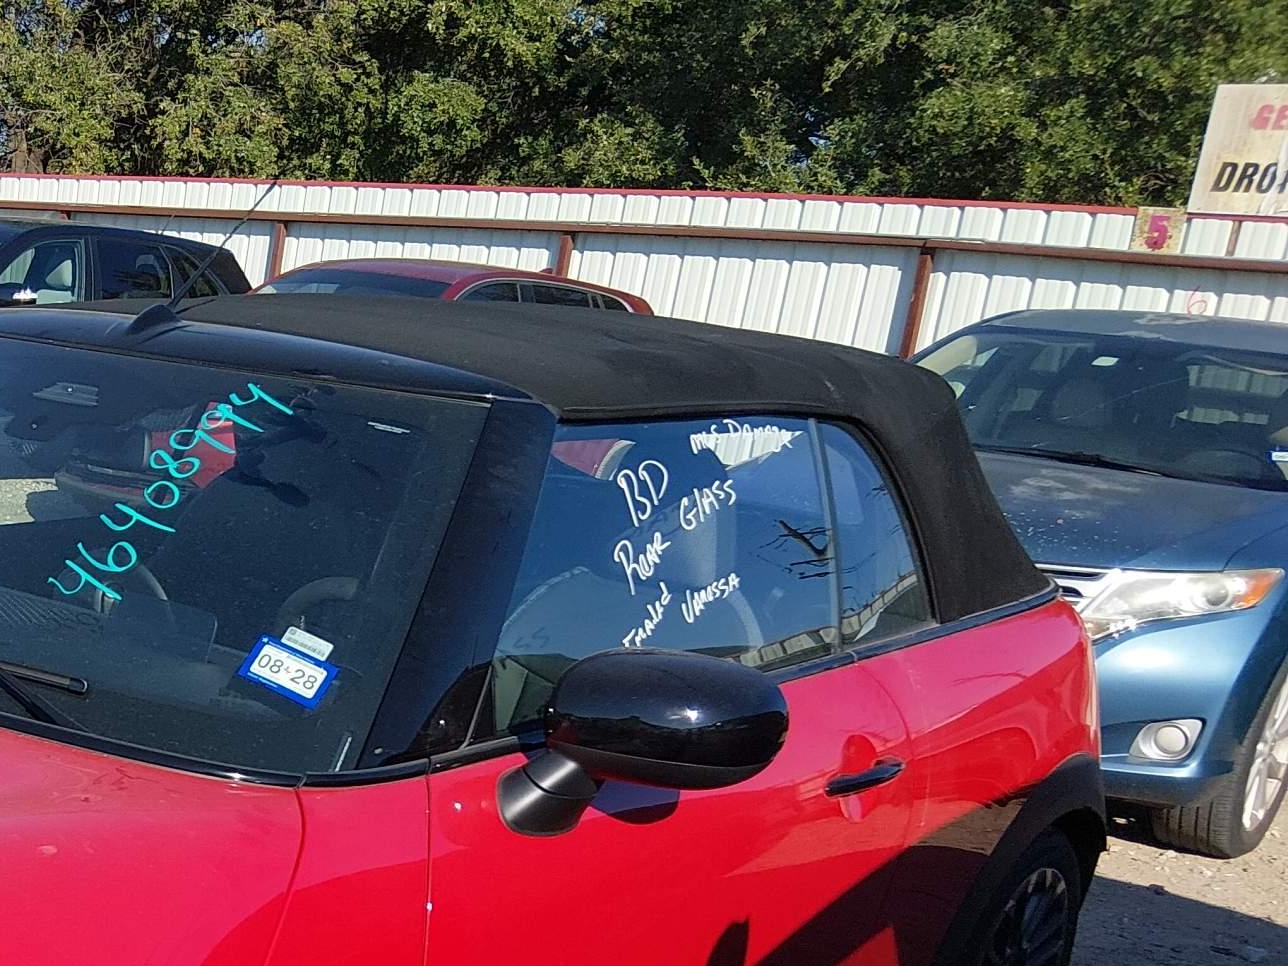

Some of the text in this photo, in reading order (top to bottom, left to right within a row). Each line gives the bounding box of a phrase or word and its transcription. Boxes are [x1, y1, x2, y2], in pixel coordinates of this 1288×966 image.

[1144, 215, 1172, 251] 5
[1187, 286, 1208, 316] 6
[47, 382, 293, 601] 46408994
[616, 459, 669, 527] BD
[257, 653, 284, 674] 08
[290, 668, 318, 690] 28
